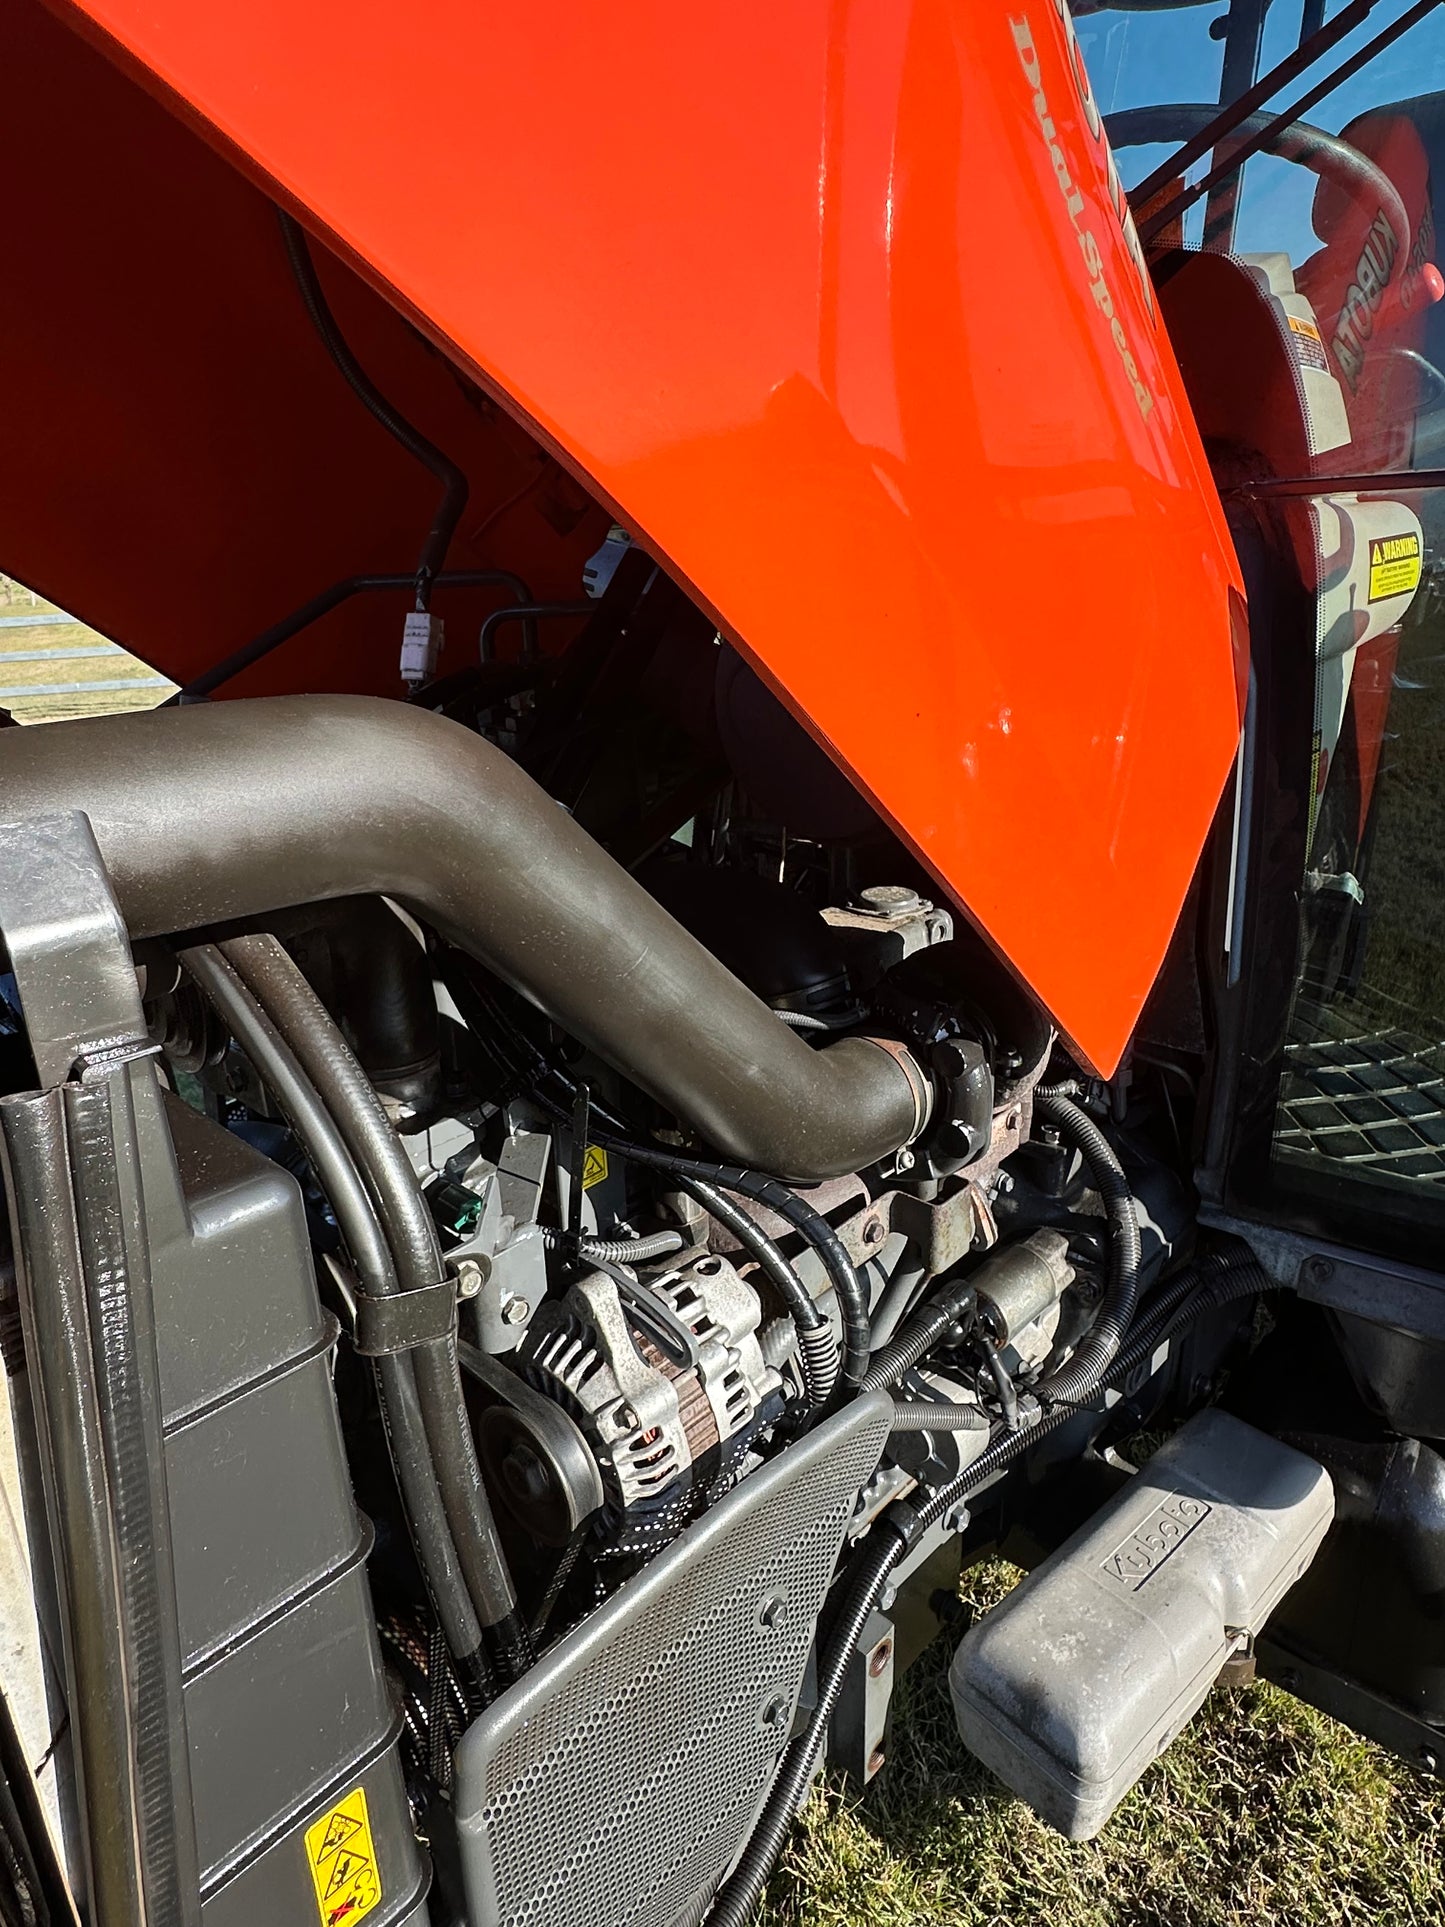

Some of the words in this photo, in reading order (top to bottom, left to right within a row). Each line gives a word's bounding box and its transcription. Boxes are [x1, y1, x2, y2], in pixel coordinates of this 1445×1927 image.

[1007, 13, 1085, 230] Dual
[1077, 230, 1154, 422] Speed
[1381, 536, 1419, 561] WARNING
[1103, 1498, 1205, 1583] Kubota
